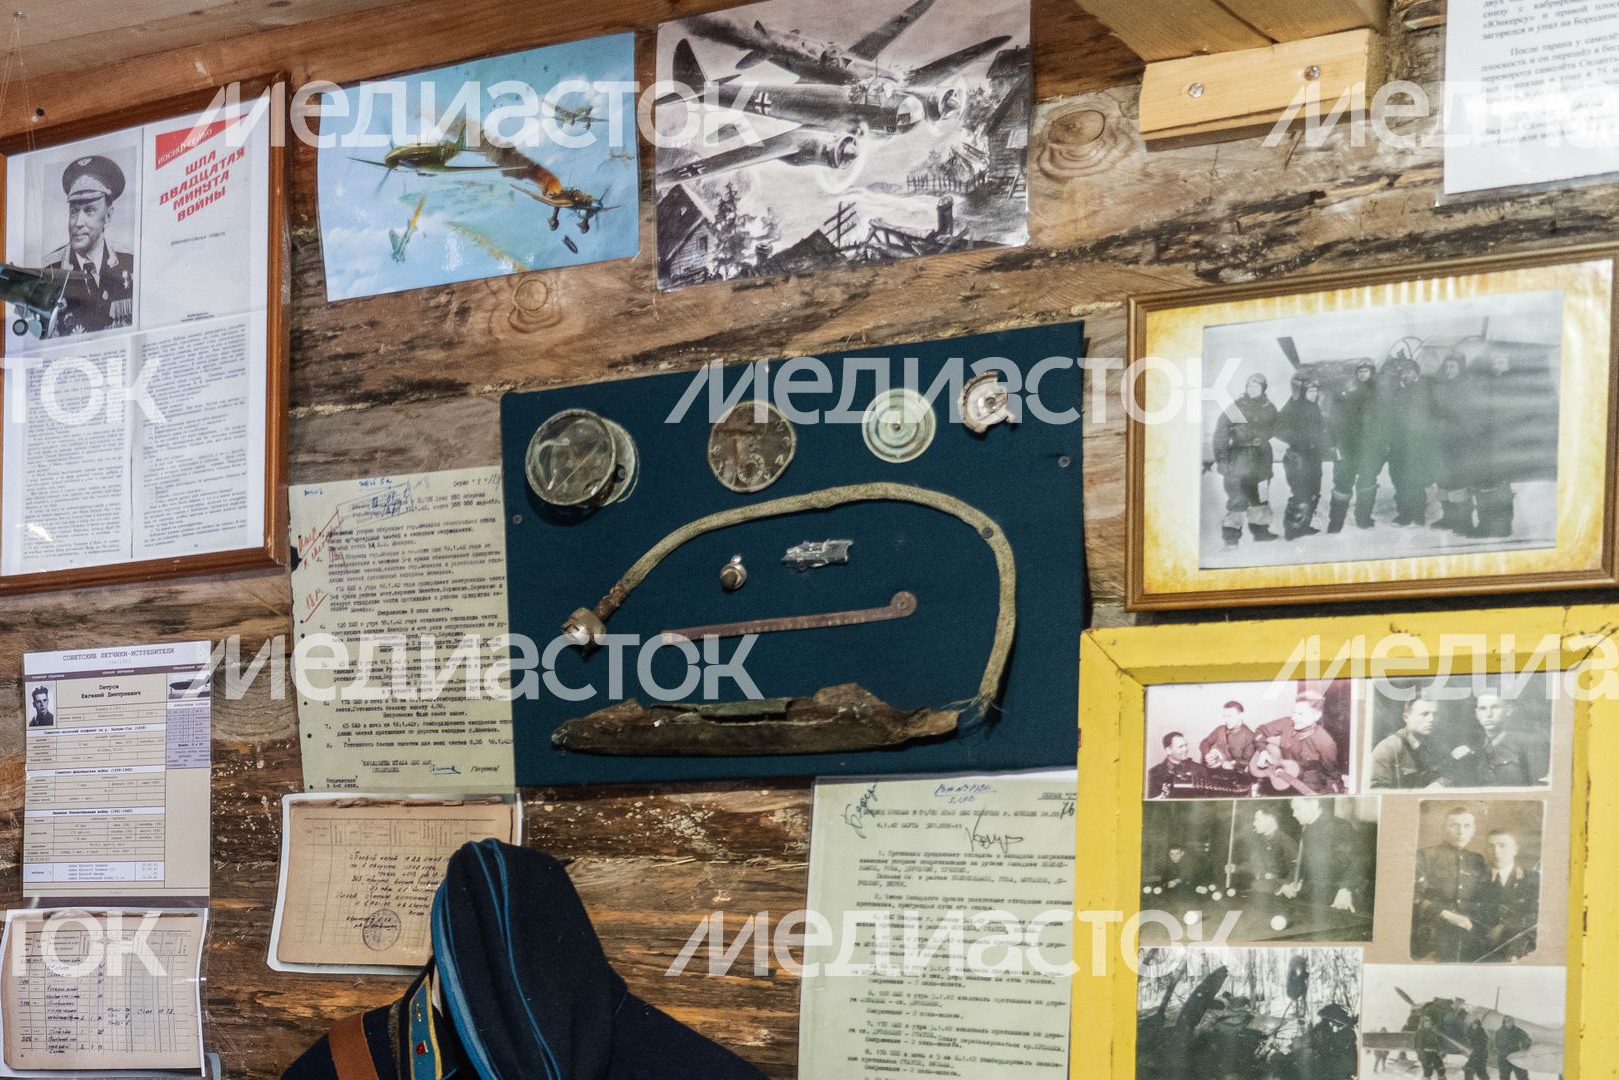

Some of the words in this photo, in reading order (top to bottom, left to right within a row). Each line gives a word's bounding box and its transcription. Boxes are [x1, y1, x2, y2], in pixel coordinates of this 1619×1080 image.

[1482, 29, 1525, 40] загорелся
[1536, 23, 1558, 33] упал
[1510, 46, 1538, 56] После
[186, 150, 216, 176] ШЛА
[159, 146, 245, 206] ДВАДЦАТАЯ
[173, 170, 229, 211] МИНУТА
[63, 653, 97, 661] СОВЕТСКИЕ
